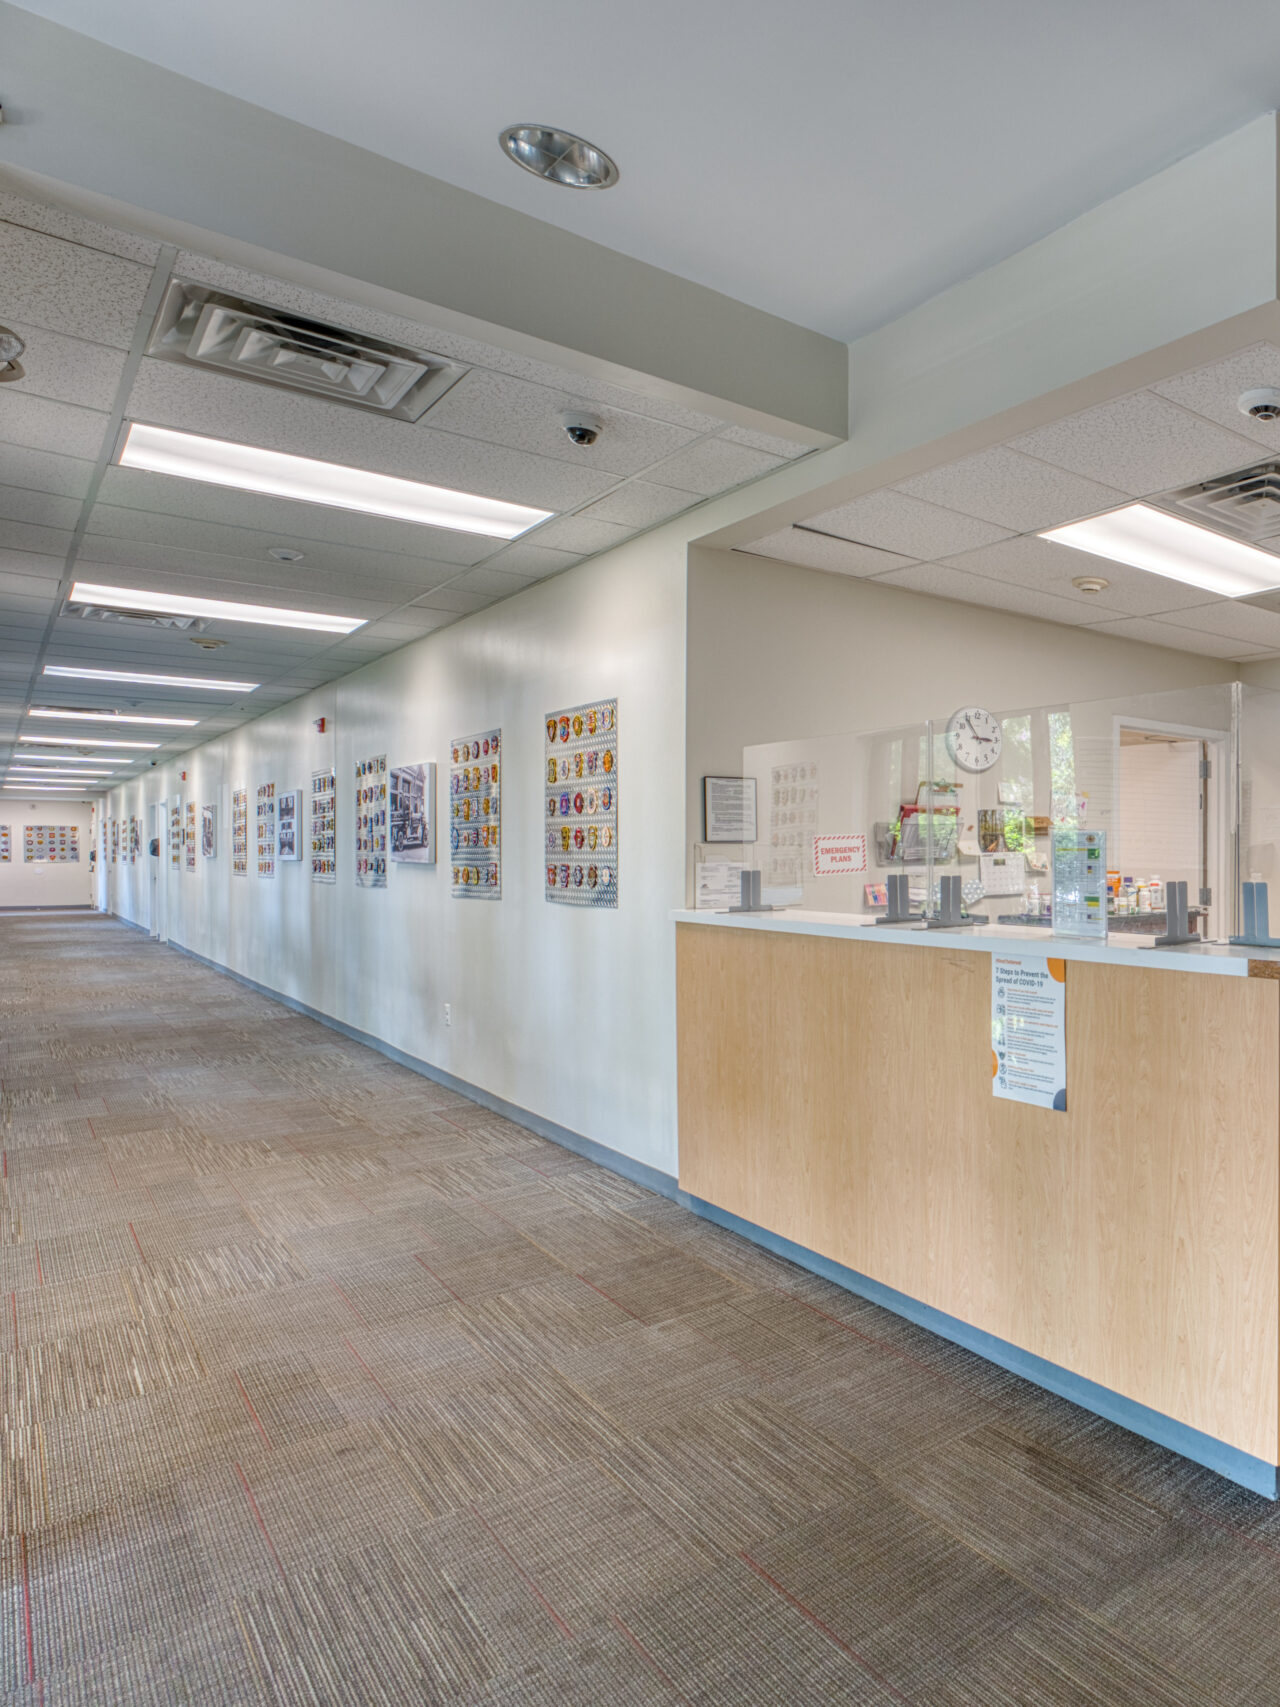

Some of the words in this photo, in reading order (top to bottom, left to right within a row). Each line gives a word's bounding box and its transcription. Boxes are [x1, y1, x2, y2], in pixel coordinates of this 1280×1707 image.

[821, 846, 860, 855] EMERGENCY
[830, 855, 852, 863] PLANS
[1000, 967, 1013, 976] Steps
[1020, 970, 1039, 978] Prevent
[1040, 971, 1049, 979] the
[995, 976, 1012, 984] Spread
[1019, 979, 1044, 988] COVID-19
